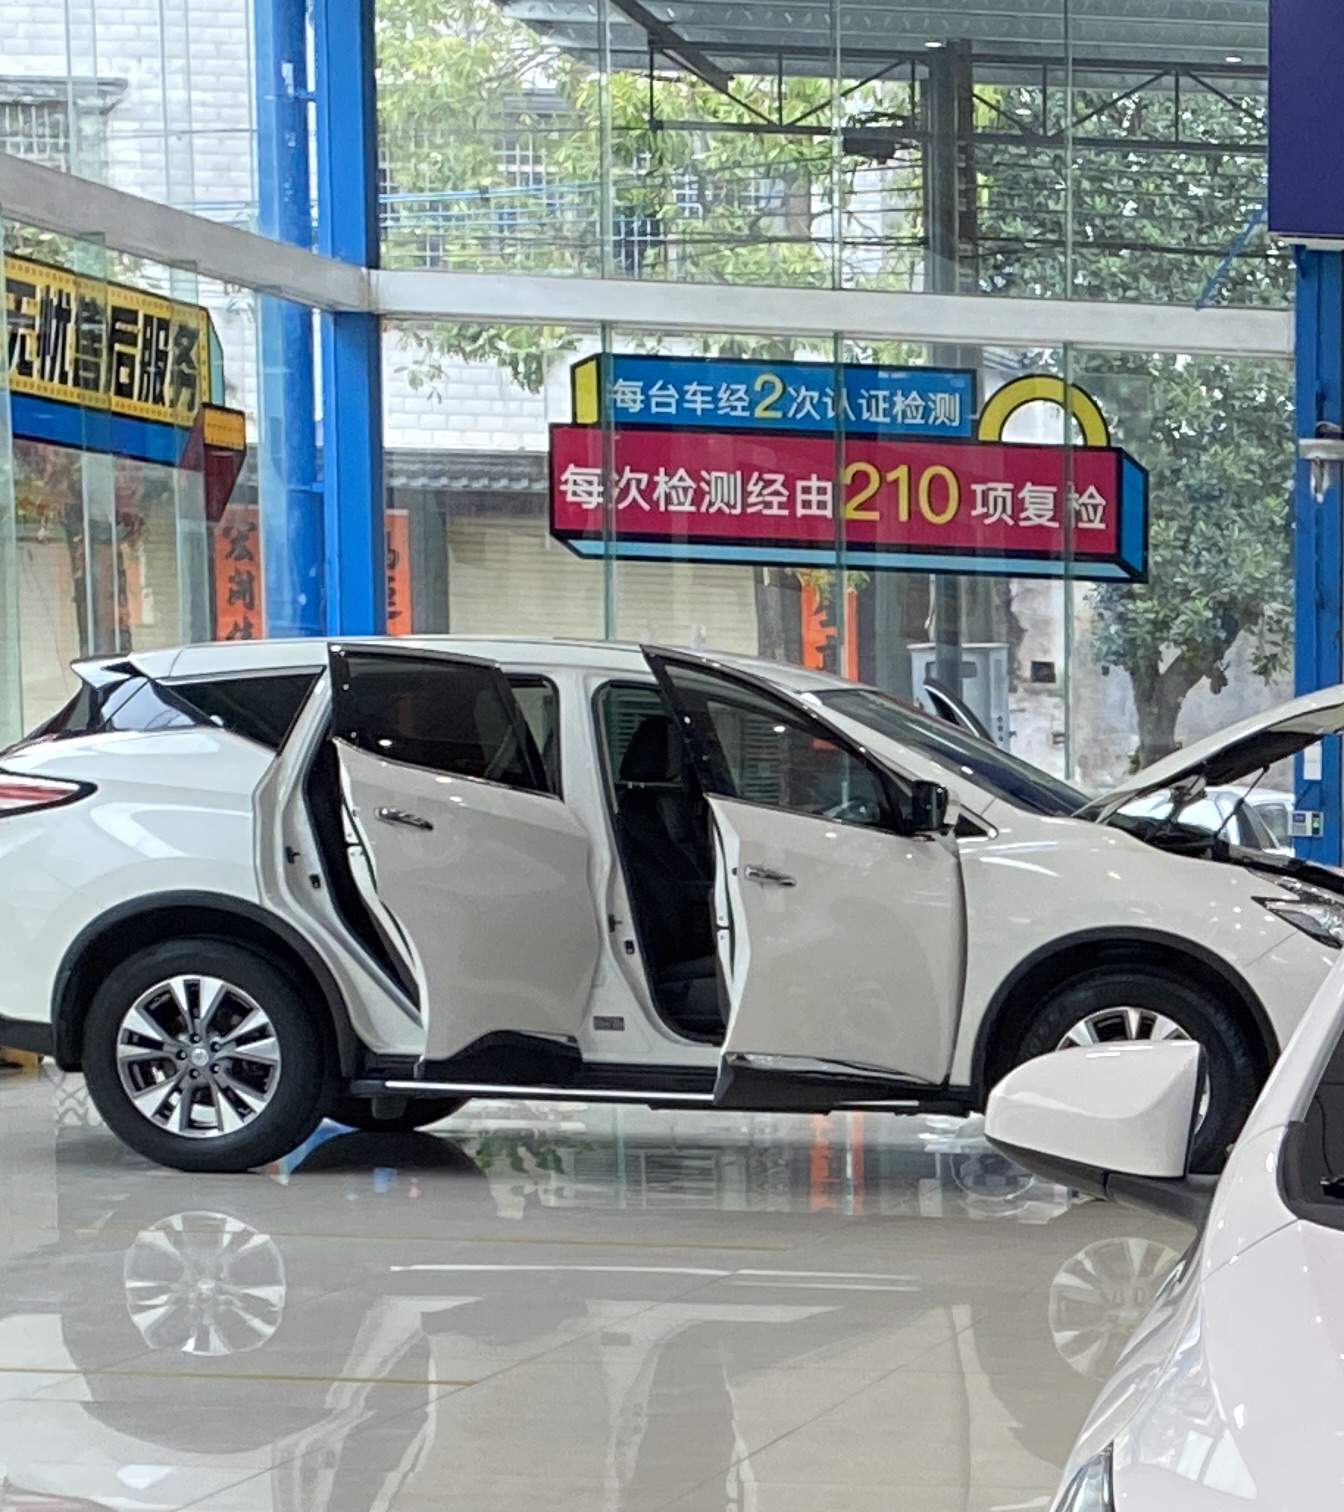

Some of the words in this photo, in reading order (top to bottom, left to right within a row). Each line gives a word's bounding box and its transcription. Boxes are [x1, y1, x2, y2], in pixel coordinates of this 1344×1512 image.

[612, 374, 961, 428] 每台车经2次认证检测
[559, 461, 1108, 531] 每次检测经由210项复检
